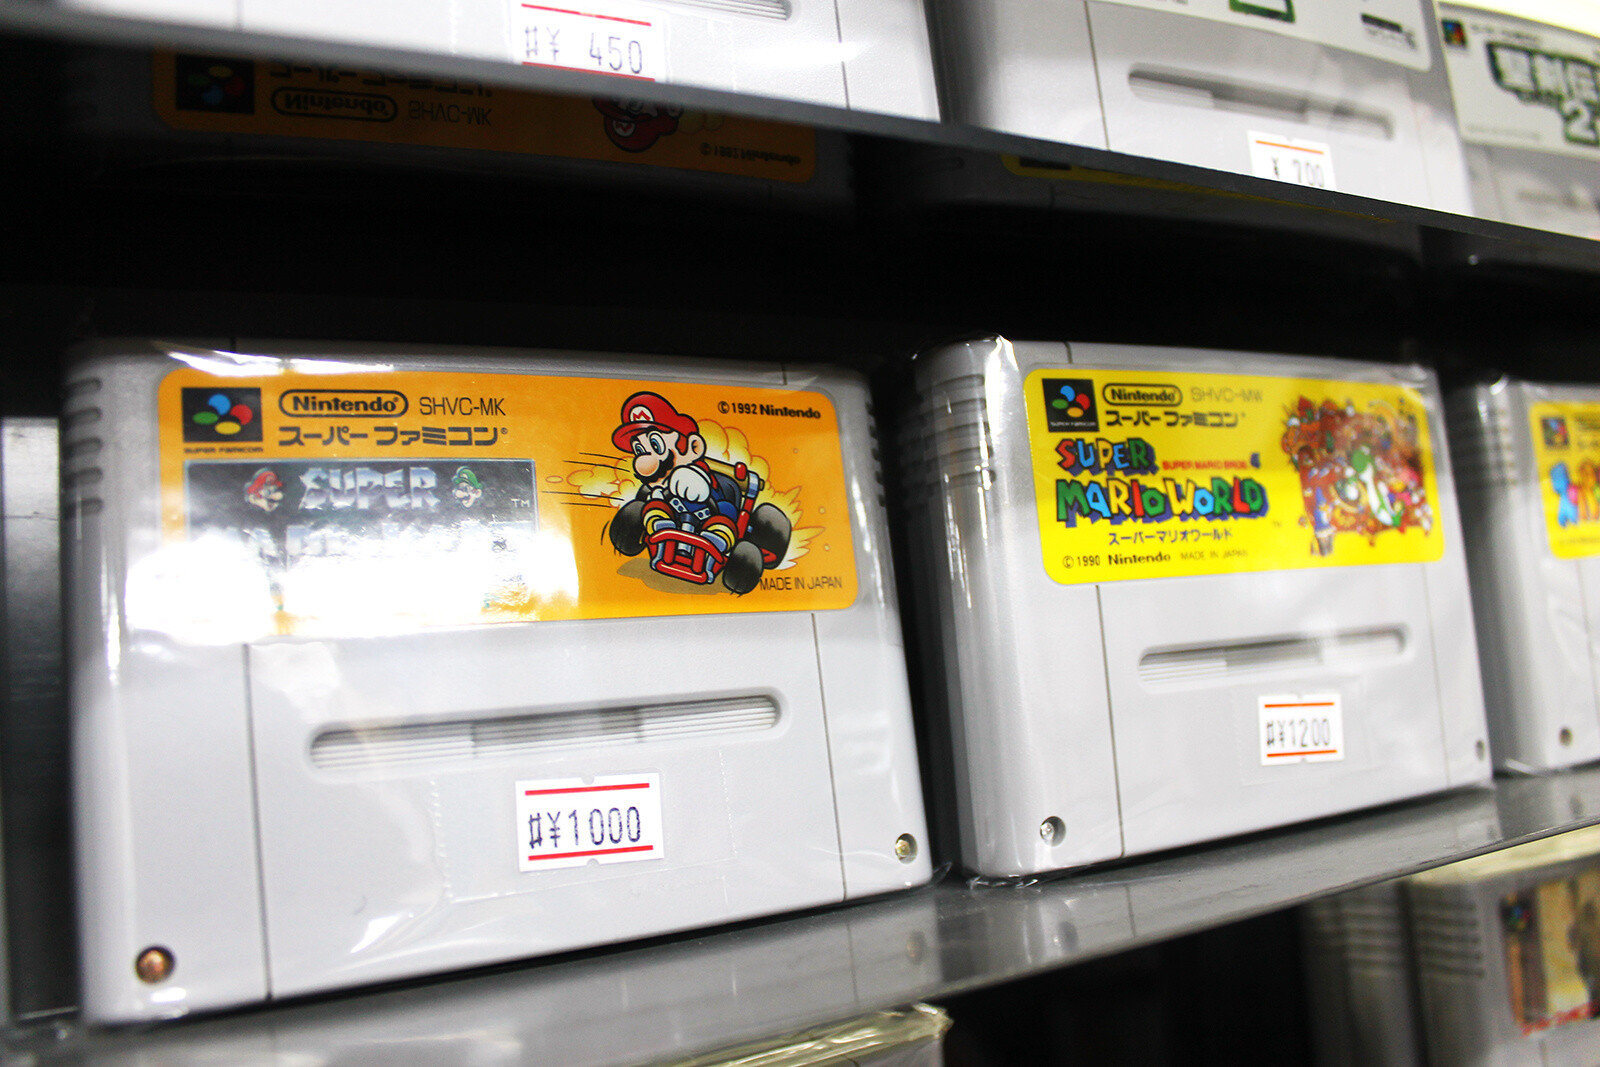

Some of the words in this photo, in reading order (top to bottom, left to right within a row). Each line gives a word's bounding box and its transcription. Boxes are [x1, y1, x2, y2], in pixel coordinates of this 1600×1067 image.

[589, 32, 643, 75] 450
[1291, 158, 1325, 188] 700
[1110, 388, 1176, 402] Nintendo
[292, 395, 397, 412] Nintendo
[419, 396, 507, 416] SHVC-MK
[759, 404, 822, 419] Nintendo
[1055, 437, 1157, 474] SUPER
[298, 466, 441, 510] SUPER
[1108, 527, 1233, 546] スーパーマリオワールド
[1107, 551, 1172, 567] Nintendo
[760, 577, 792, 591] MADE
[794, 577, 806, 590] IN
[807, 575, 843, 590] JAPAN
